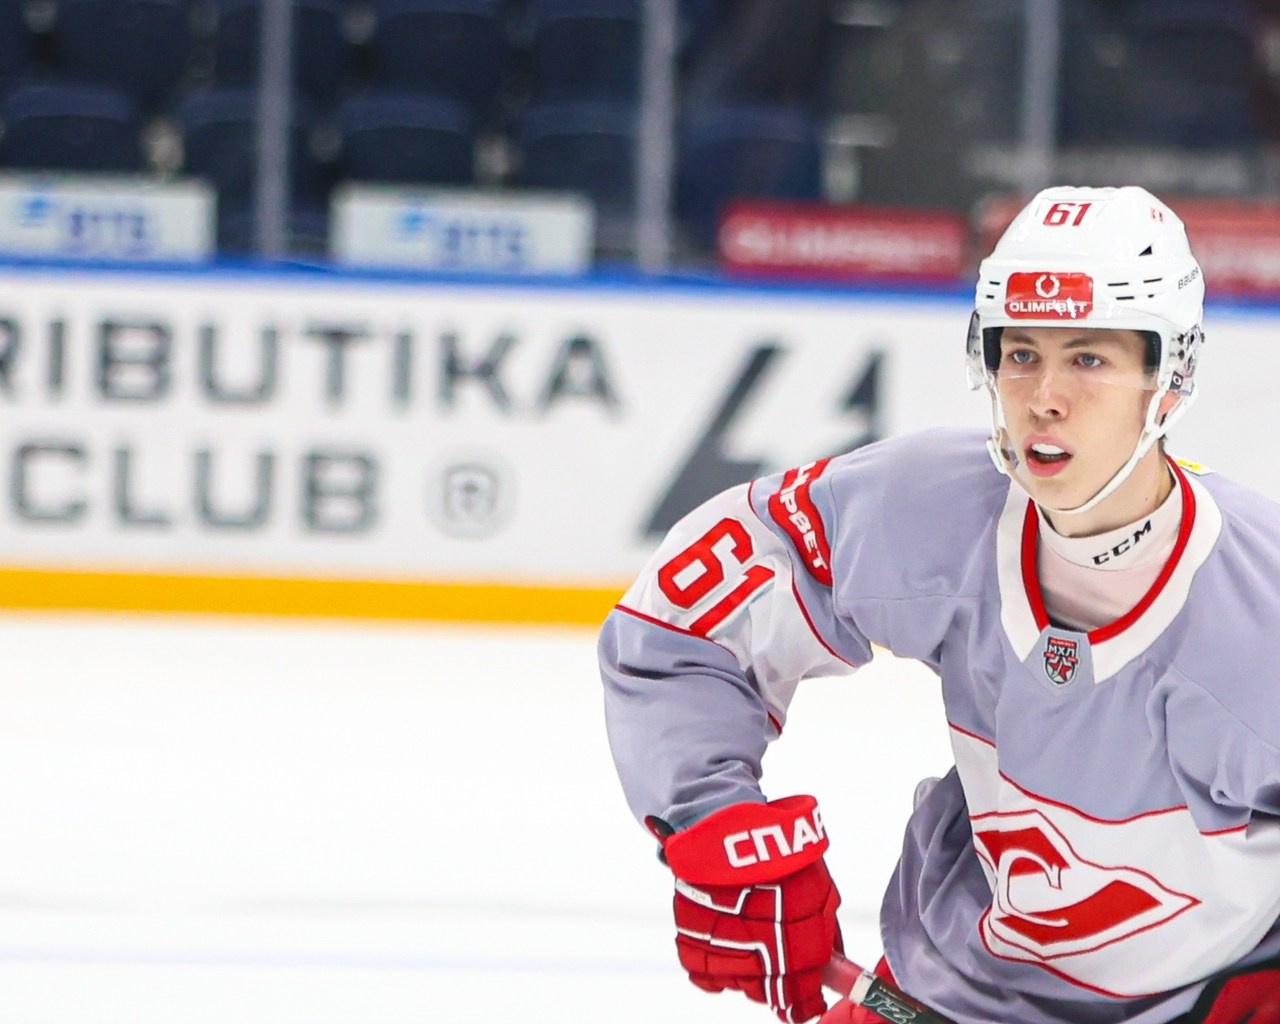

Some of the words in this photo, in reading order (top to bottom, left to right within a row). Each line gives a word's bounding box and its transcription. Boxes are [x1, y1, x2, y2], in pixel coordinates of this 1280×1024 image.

[1042, 202, 1093, 227] 61
[12, 441, 380, 535] CLUB
[1092, 520, 1152, 565] CCM
[657, 517, 776, 638] 61
